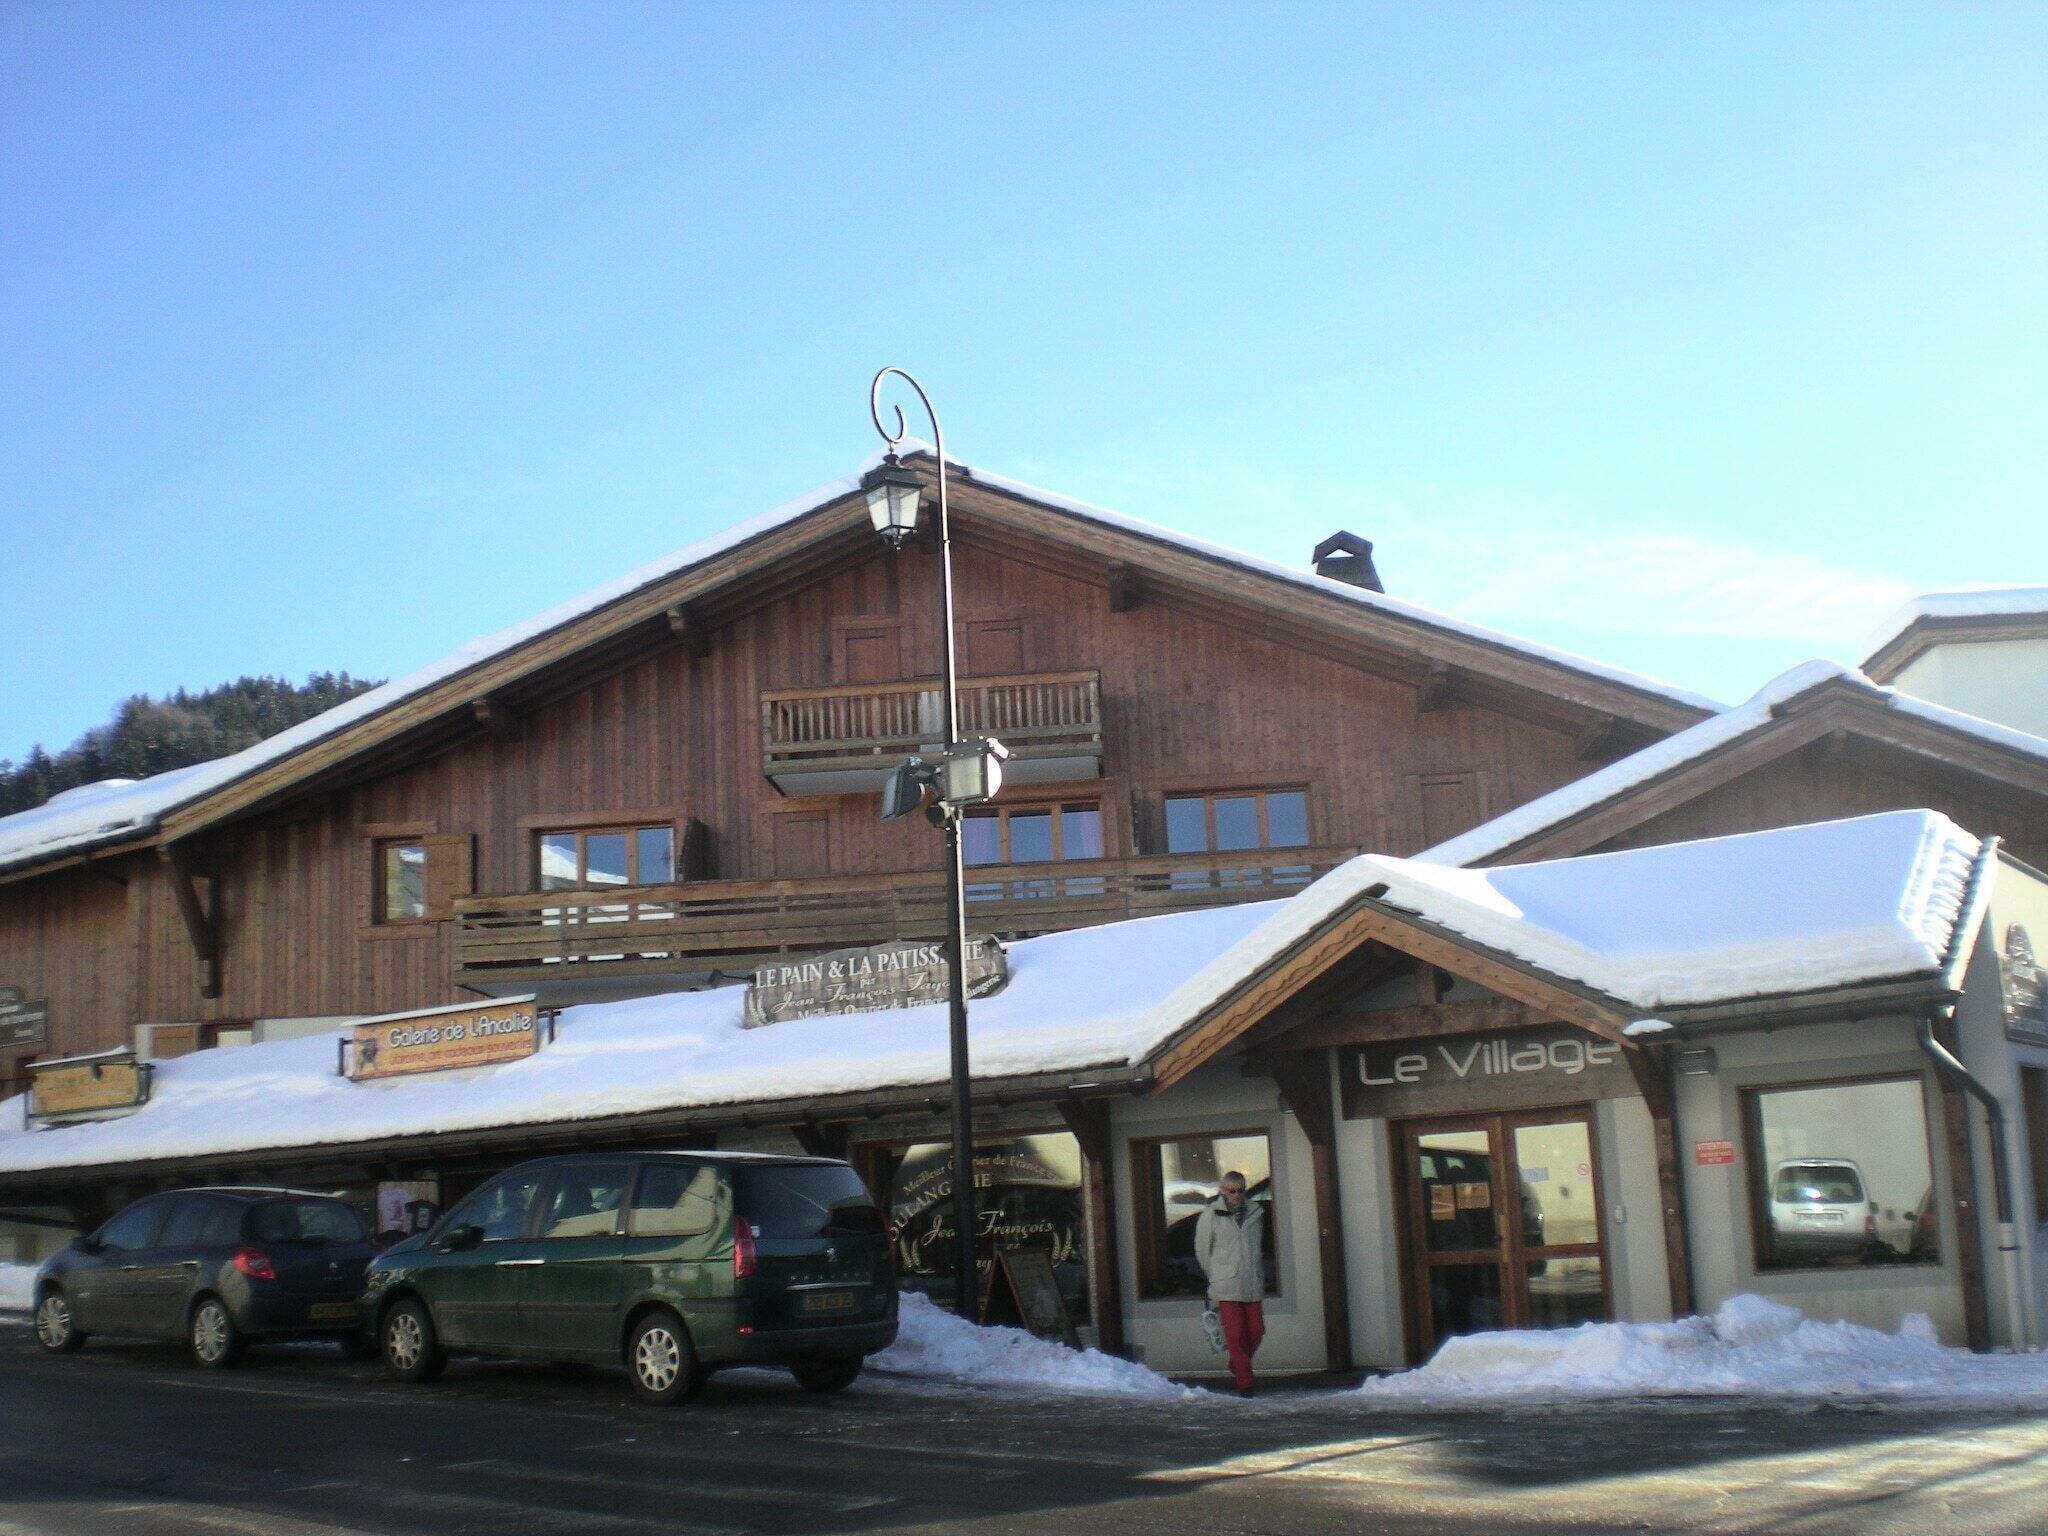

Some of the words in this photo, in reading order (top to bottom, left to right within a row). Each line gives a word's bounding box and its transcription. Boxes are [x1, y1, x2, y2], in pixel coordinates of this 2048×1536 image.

[755, 967, 777, 988] LE
[781, 961, 824, 985] PAIN
[828, 960, 846, 979] &
[848, 957, 873, 977] LA
[877, 943, 984, 973] PATISSIE
[771, 991, 815, 1014] Jean
[388, 1027, 440, 1048] Galerie
[443, 1020, 465, 1040] de
[1358, 1053, 1428, 1086] Le
[1437, 1039, 1622, 1078] Village
[920, 1214, 956, 1246] Jea
